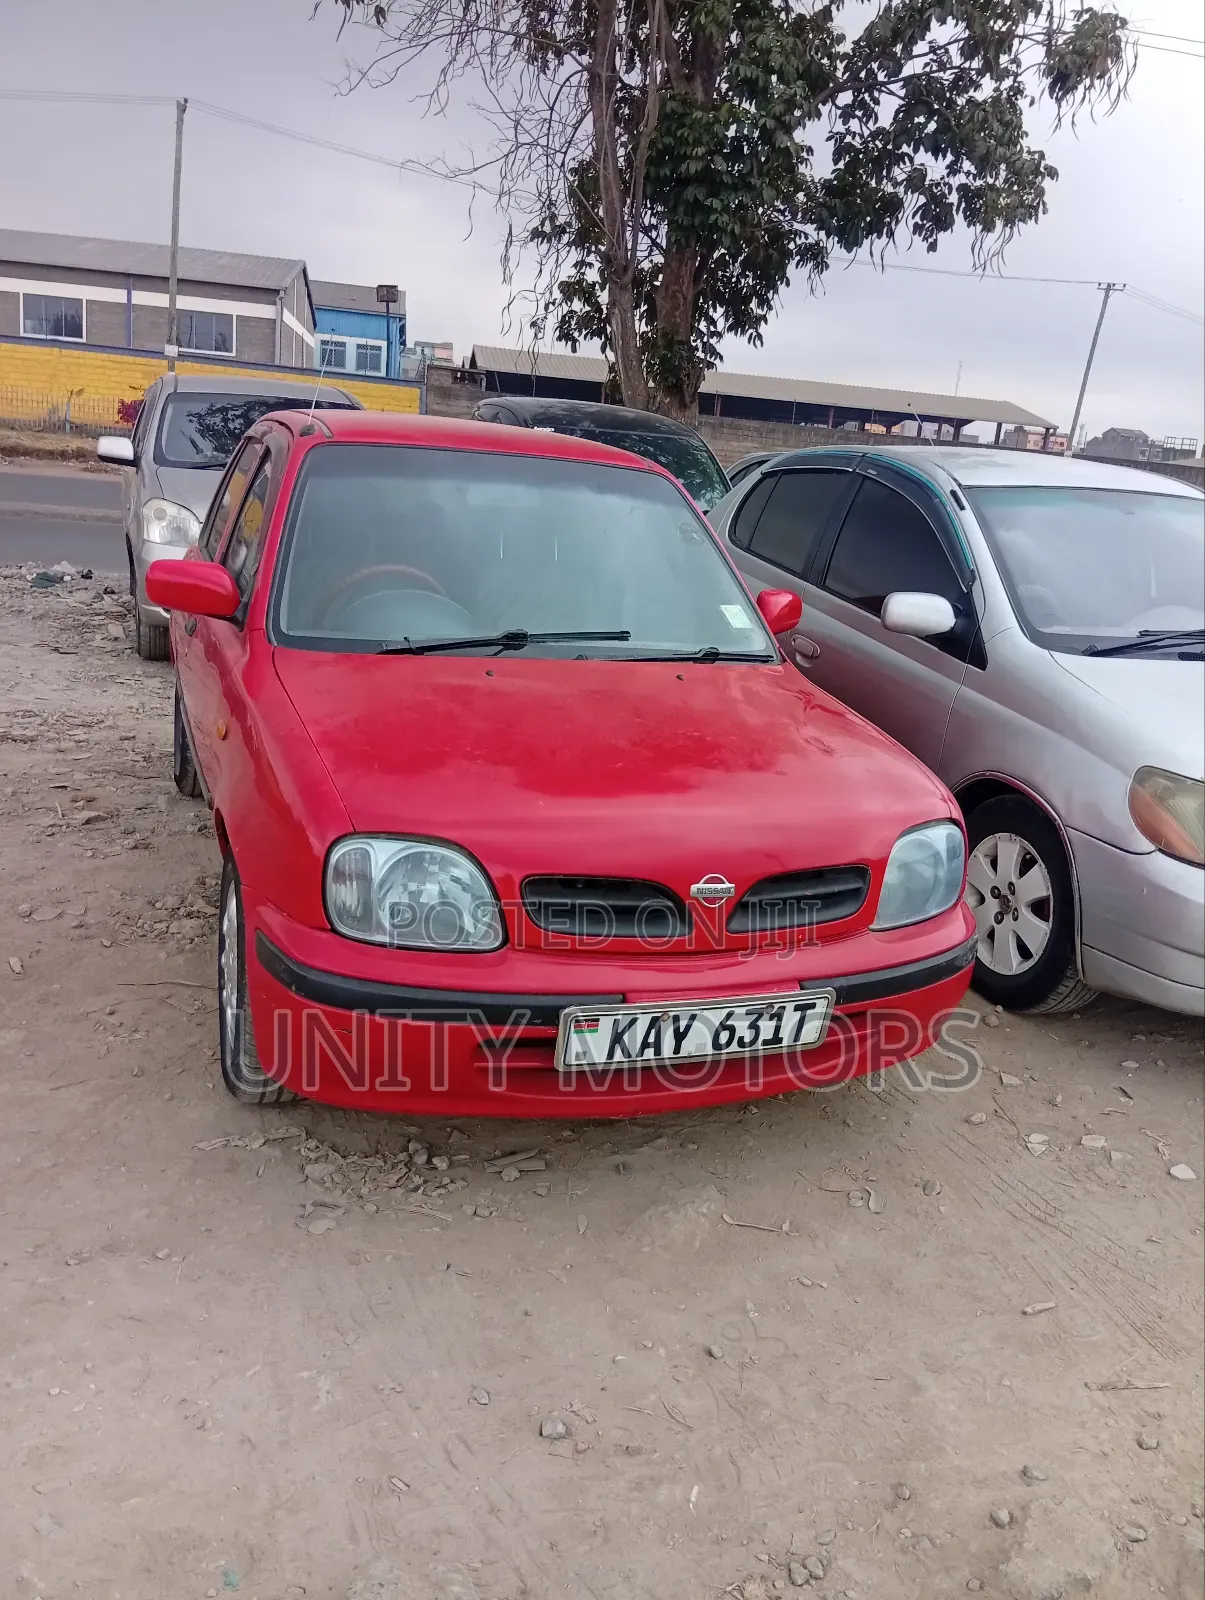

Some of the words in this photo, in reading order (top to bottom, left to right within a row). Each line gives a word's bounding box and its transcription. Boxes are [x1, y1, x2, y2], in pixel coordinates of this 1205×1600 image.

[696, 886, 731, 896] NISSAN
[606, 1012, 698, 1061] KAY
[711, 1001, 817, 1051] 631T
